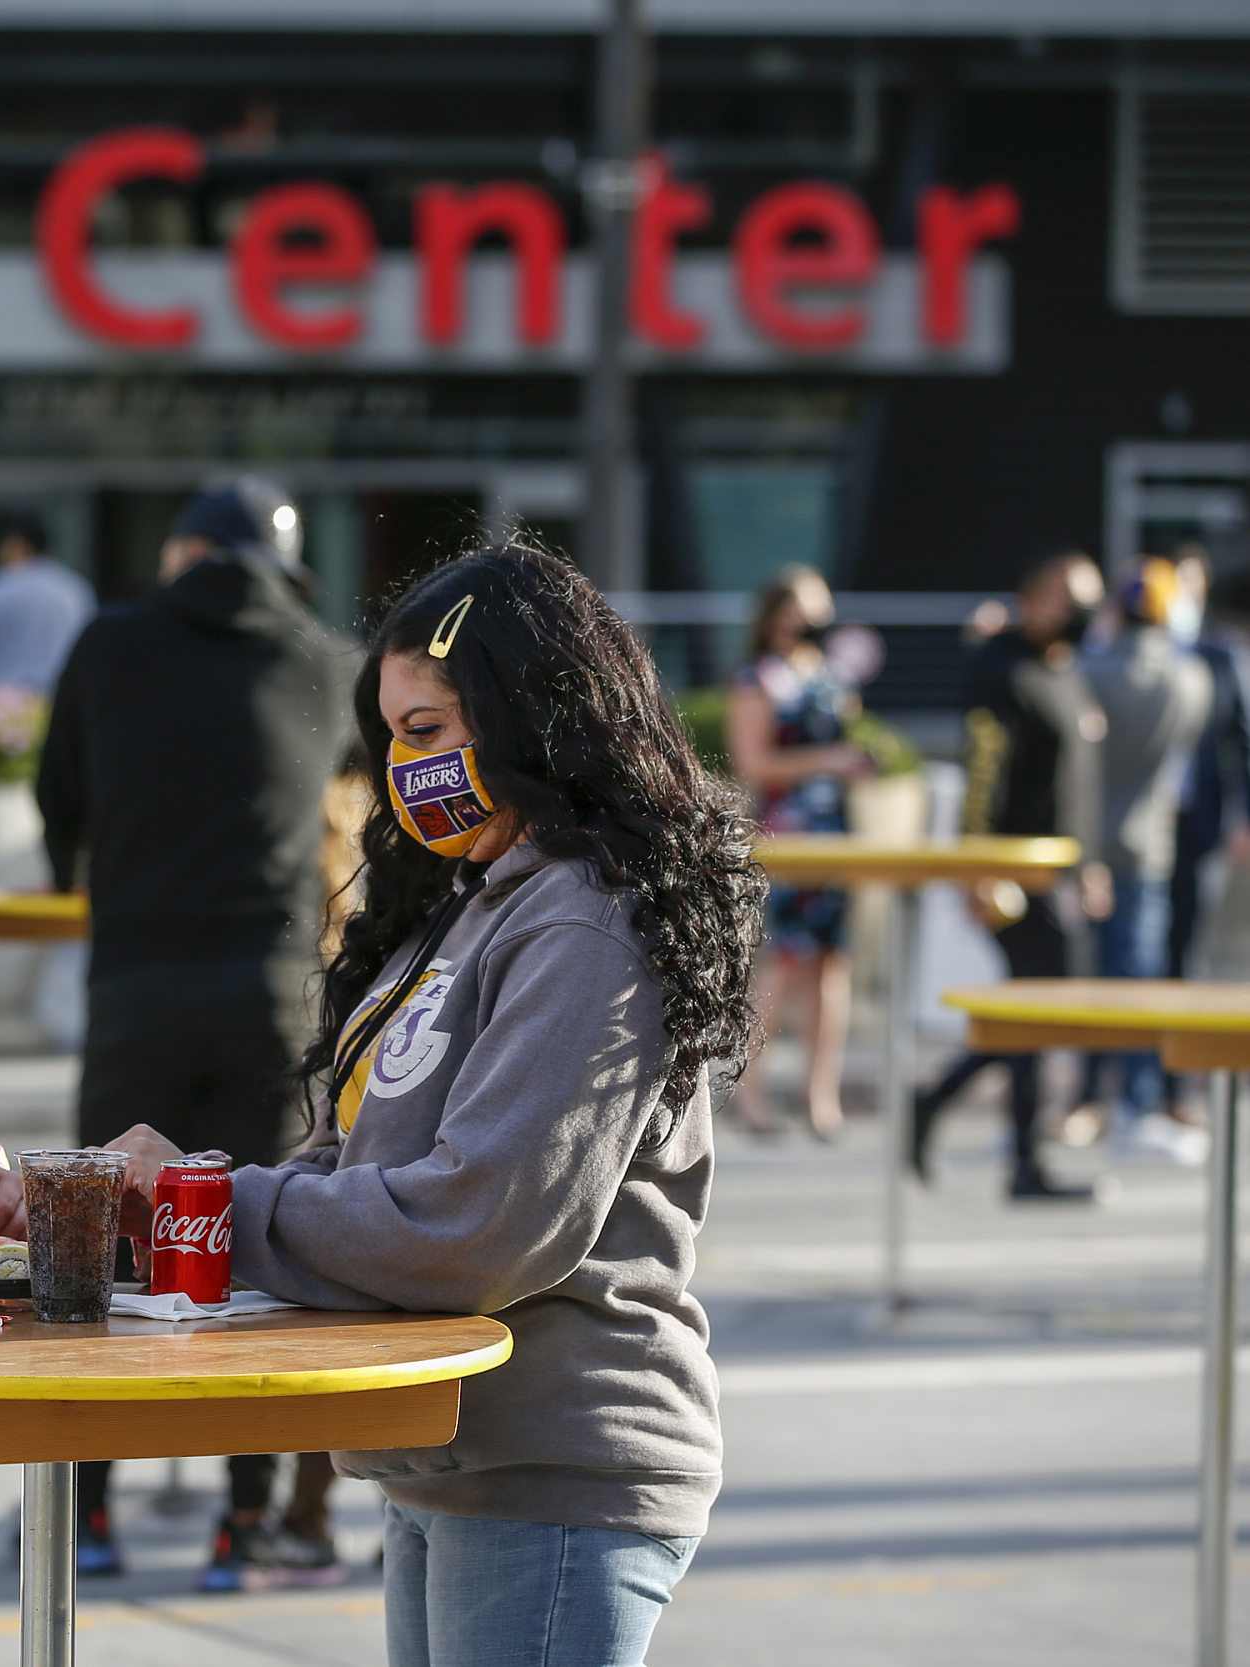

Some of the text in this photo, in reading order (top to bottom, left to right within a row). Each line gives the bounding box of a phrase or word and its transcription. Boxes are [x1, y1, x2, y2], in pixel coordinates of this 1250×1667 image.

[36, 127, 1018, 351] Center
[403, 766, 465, 798] LAKERS
[429, 760, 459, 772] ANGELES
